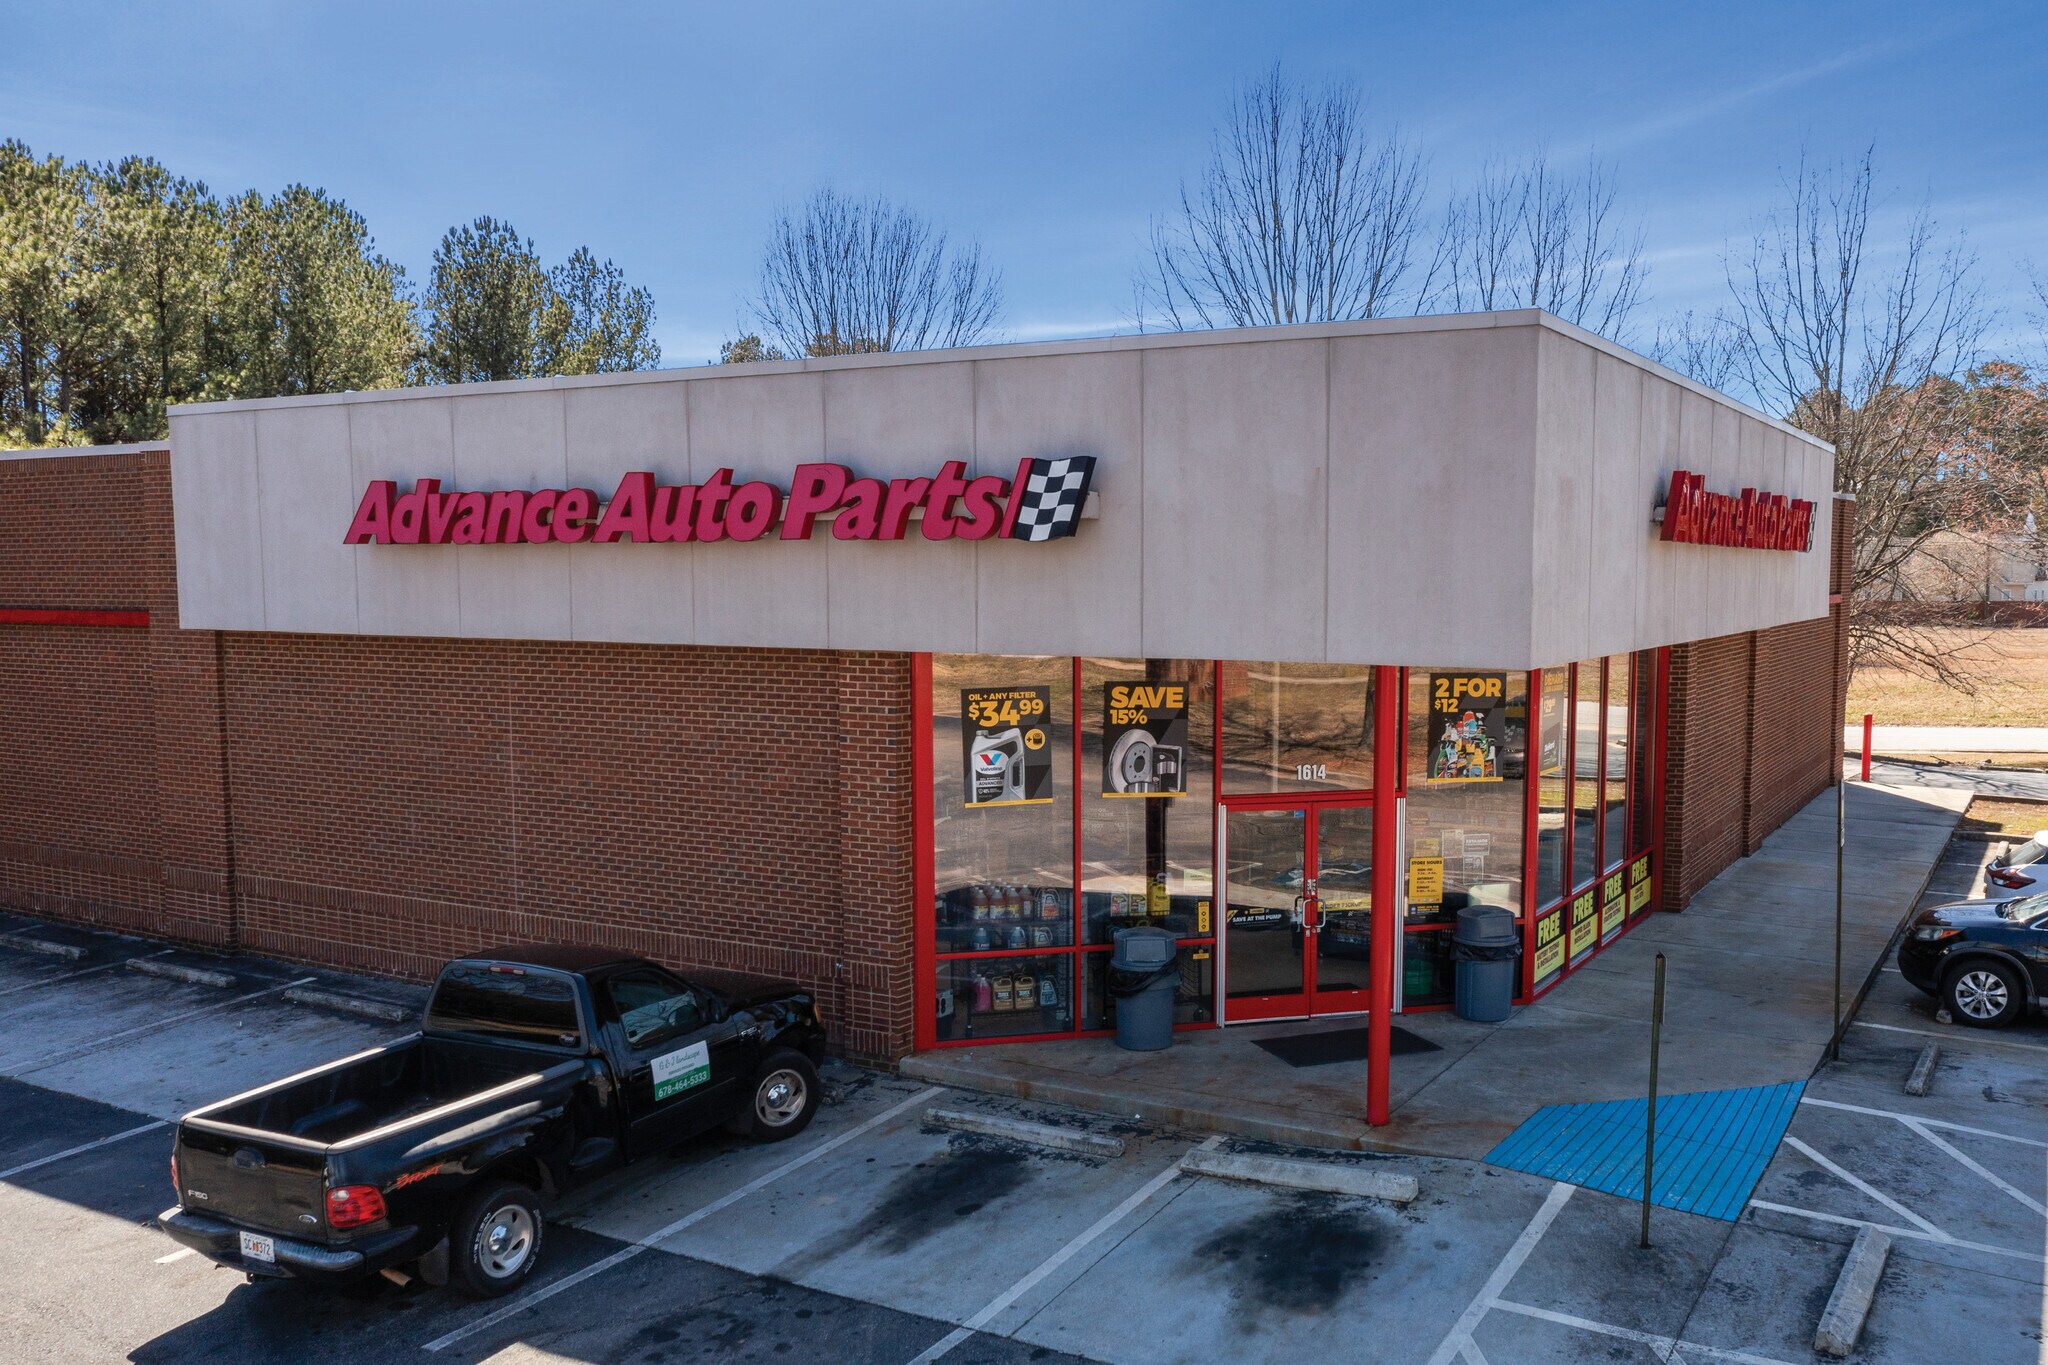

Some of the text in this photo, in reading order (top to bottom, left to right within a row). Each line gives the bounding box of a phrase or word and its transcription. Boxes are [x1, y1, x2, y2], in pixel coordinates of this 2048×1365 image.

[343, 461, 1012, 545] Advance Auto Parts
[1661, 470, 1809, 551] Advance Auto Parts
[967, 693, 983, 701] OIL
[989, 692, 1008, 700] ANY
[1008, 691, 1037, 699] FILTER
[1110, 686, 1184, 709] SAVE
[1435, 677, 1502, 698] 2 FOR
[1109, 709, 1148, 725] 15%
[1434, 698, 1459, 713] $12
[1296, 763, 1327, 781] 1614
[1631, 855, 1648, 886] FREE
[1604, 871, 1622, 904] FREE
[1573, 890, 1593, 925] FREE
[1537, 910, 1560, 948] FREE
[658, 1071, 707, 1098] 678-464-5333
[188, 1189, 209, 1200] F150
